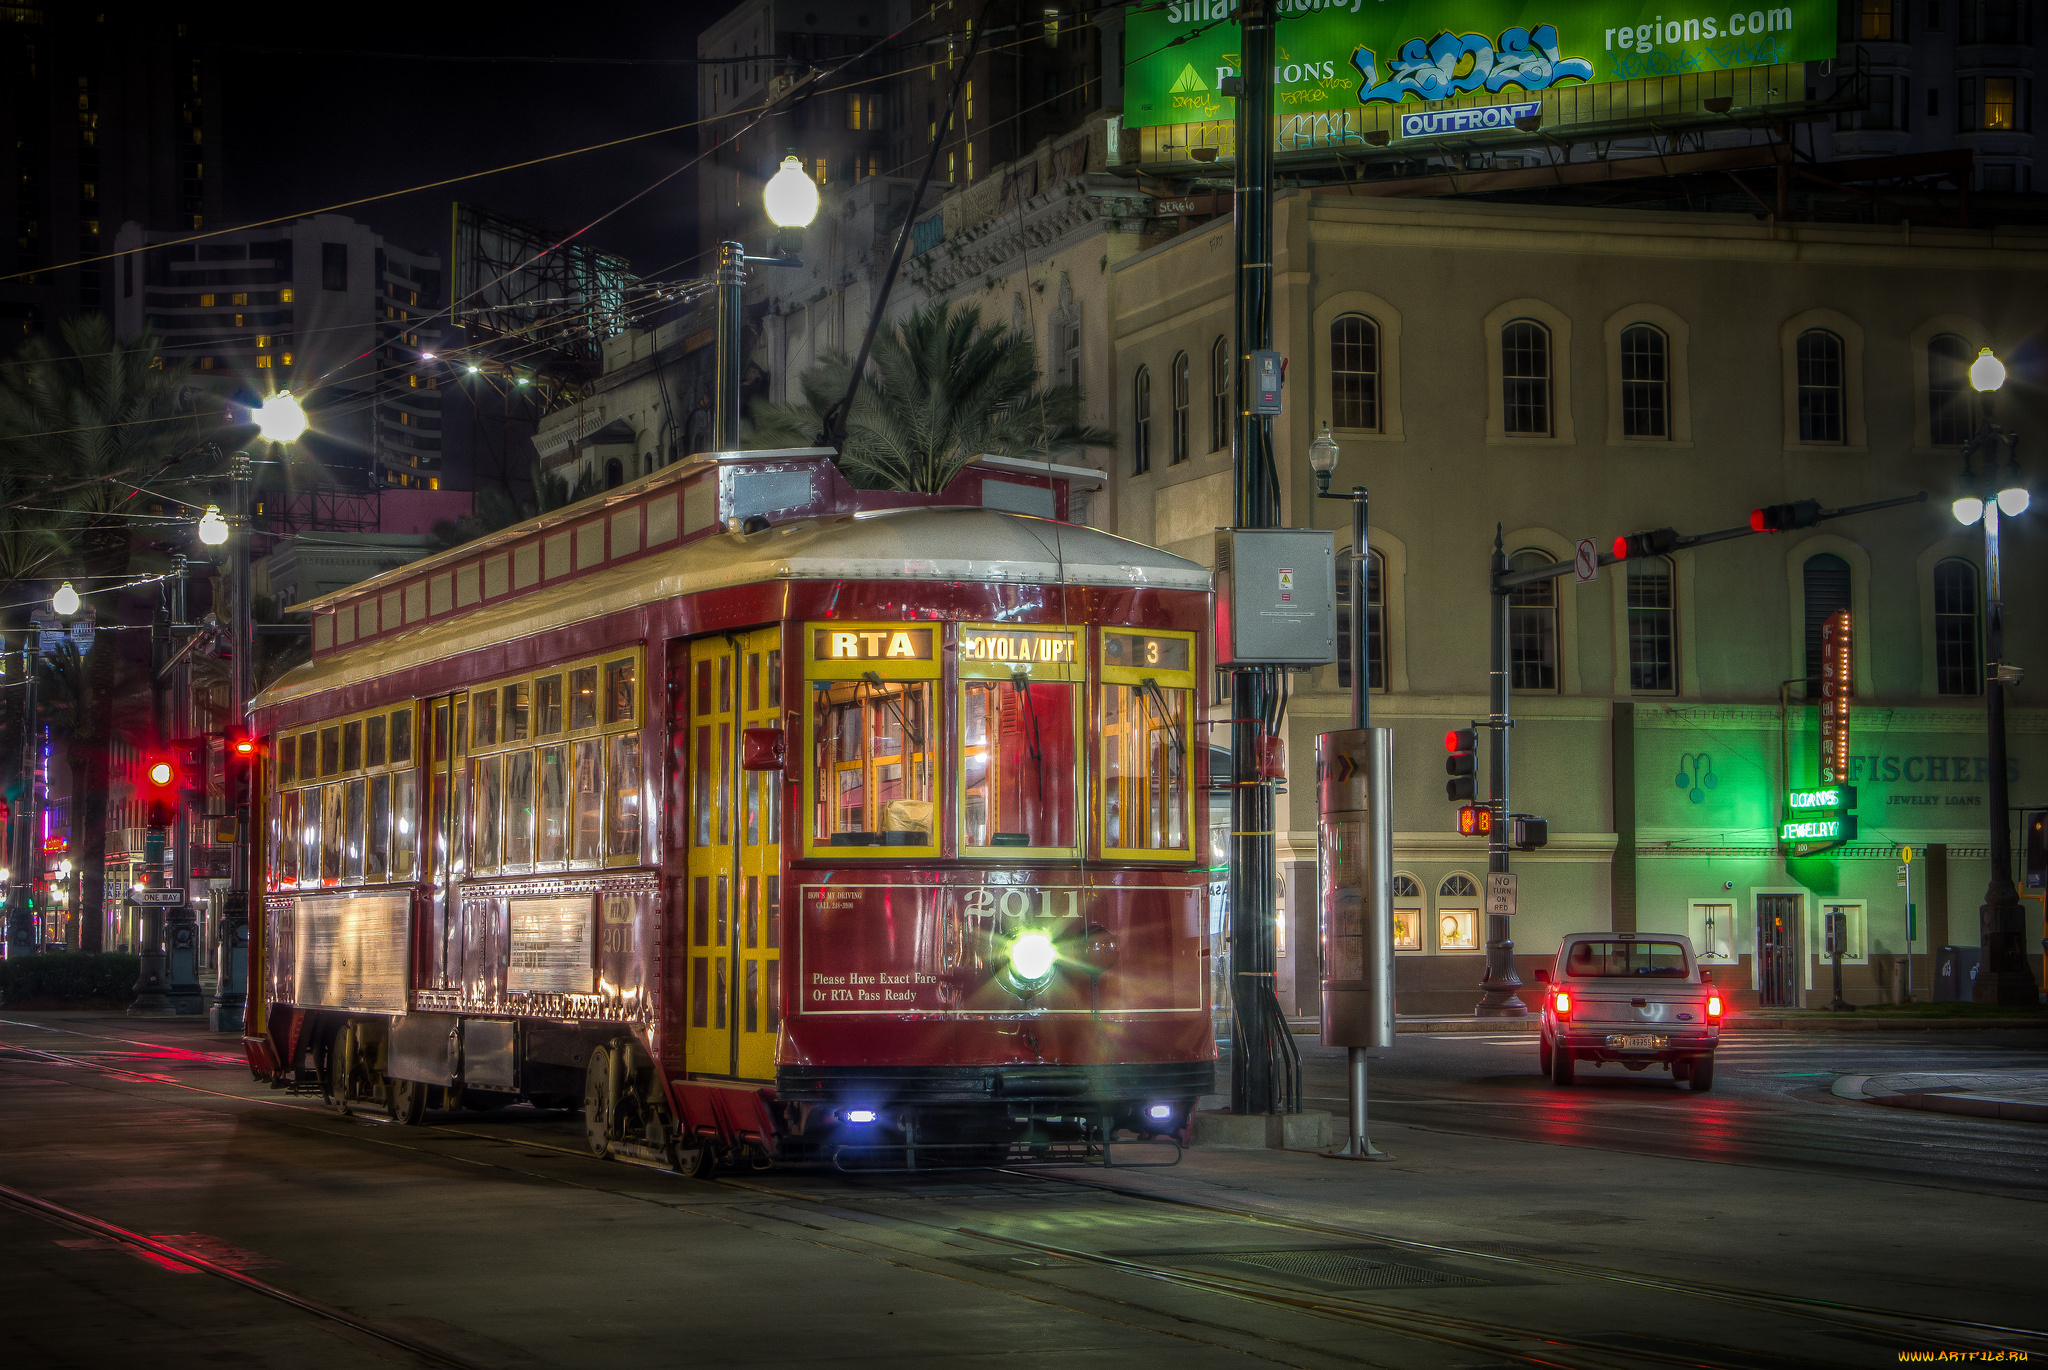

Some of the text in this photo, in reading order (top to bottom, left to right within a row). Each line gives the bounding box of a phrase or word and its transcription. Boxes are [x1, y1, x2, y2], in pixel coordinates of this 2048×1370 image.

[1605, 7, 1793, 54] regions.com
[1215, 60, 1335, 90] RIONS
[1406, 105, 1533, 135] OUTFRONT
[831, 632, 917, 657] RTA
[965, 636, 1075, 662] LOYOLA/UPT
[1146, 641, 1159, 664] 3
[1790, 790, 1839, 808] LOANS
[1886, 795, 1982, 806] JEWELRY LOANS
[1781, 821, 1839, 839] JEWELRY
[1495, 877, 1510, 886] NO
[144, 894, 160, 902] ONE
[827, 891, 836, 900] MY
[837, 891, 863, 900] DRIVING
[1493, 887, 1511, 895] TURN
[1496, 895, 1507, 903] ON
[815, 901, 831, 910] CALL
[963, 889, 1084, 918] 2011
[603, 928, 636, 953] 2011
[813, 972, 937, 985] Please Have Exact Fare
[813, 989, 917, 1003] Or RTA Pass Ready
